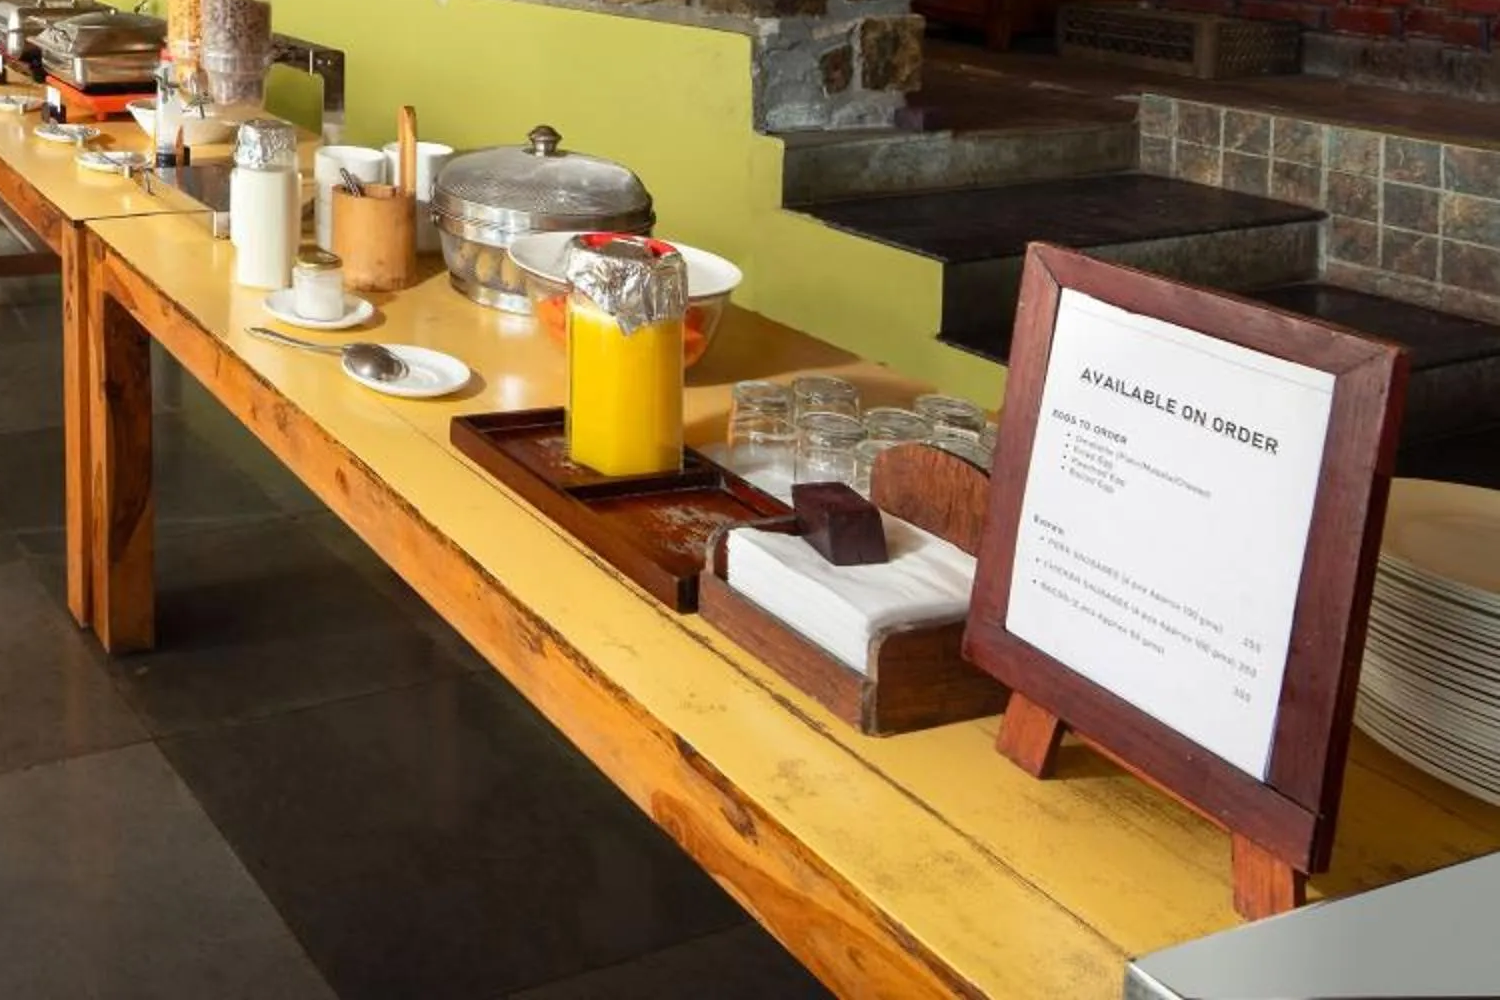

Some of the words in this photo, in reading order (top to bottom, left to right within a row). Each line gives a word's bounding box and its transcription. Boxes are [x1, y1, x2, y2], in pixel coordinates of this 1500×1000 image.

[1079, 418, 1091, 430] TO
[1094, 424, 1128, 445] ORDER
[1080, 367, 1177, 415] AVAILABLE
[1181, 404, 1208, 427] ON
[1212, 416, 1279, 455] ORDER
